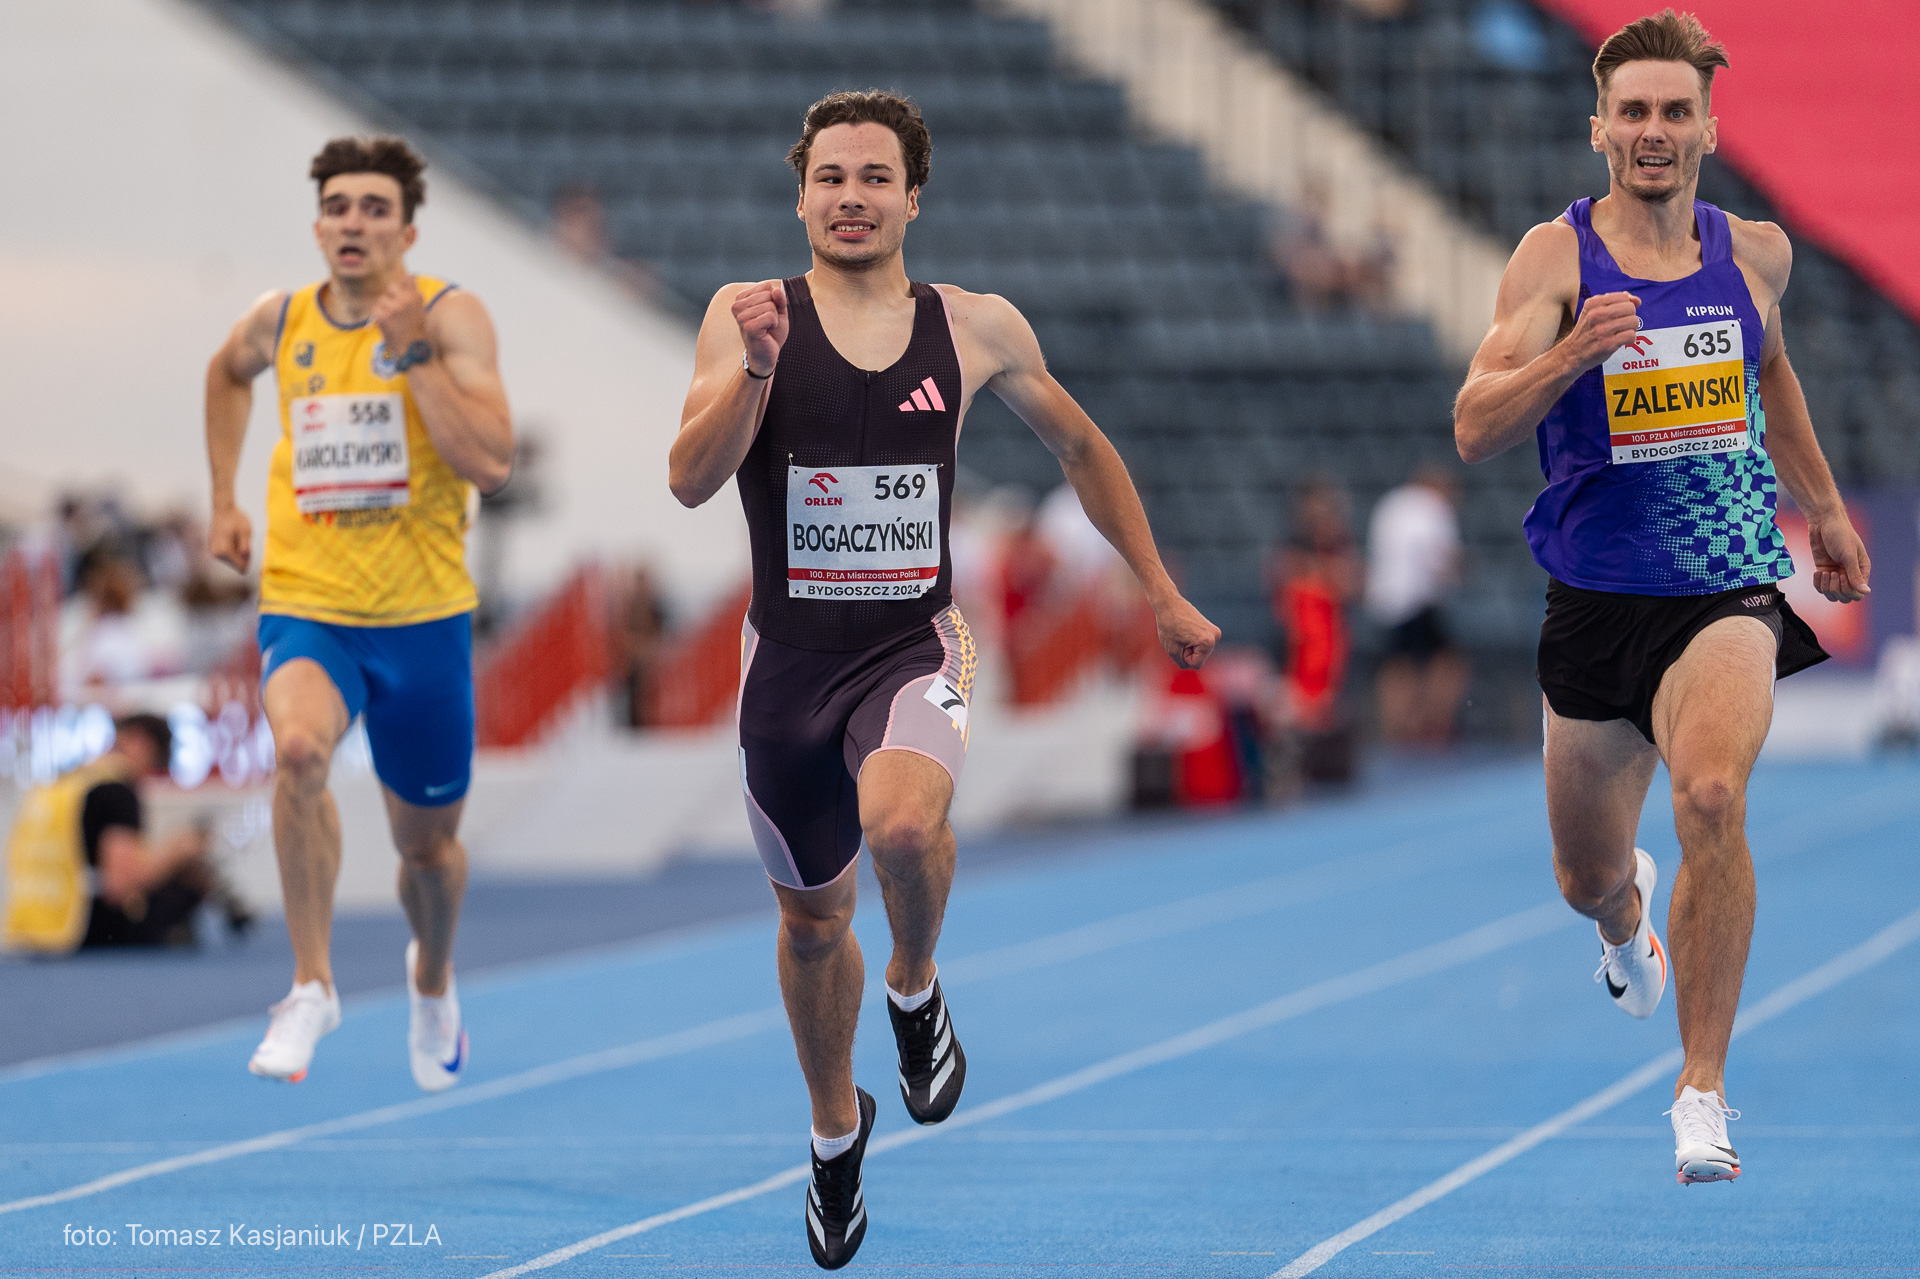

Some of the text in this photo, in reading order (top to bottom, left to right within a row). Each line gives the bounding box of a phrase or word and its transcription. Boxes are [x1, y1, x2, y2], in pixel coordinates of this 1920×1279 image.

[1685, 305, 1734, 317] KIPRUN
[1683, 329, 1732, 358] 635
[1622, 358, 1660, 371] ORLEN
[1612, 375, 1741, 418] ZALEWSKI
[350, 401, 391, 425] 558
[1631, 422, 1736, 443] 100. PZLA Mistrzostwa Polski
[1631, 437, 1738, 459] BYDGOSZCZ 2024
[874, 473, 926, 500] 569
[804, 496, 843, 507] ORLEN
[792, 516, 933, 553] BOGACZYŃSKI
[809, 569, 920, 580] 100. PZLA Mistrzostwa Polski
[807, 584, 922, 596] BYDGOSZCZ 2024
